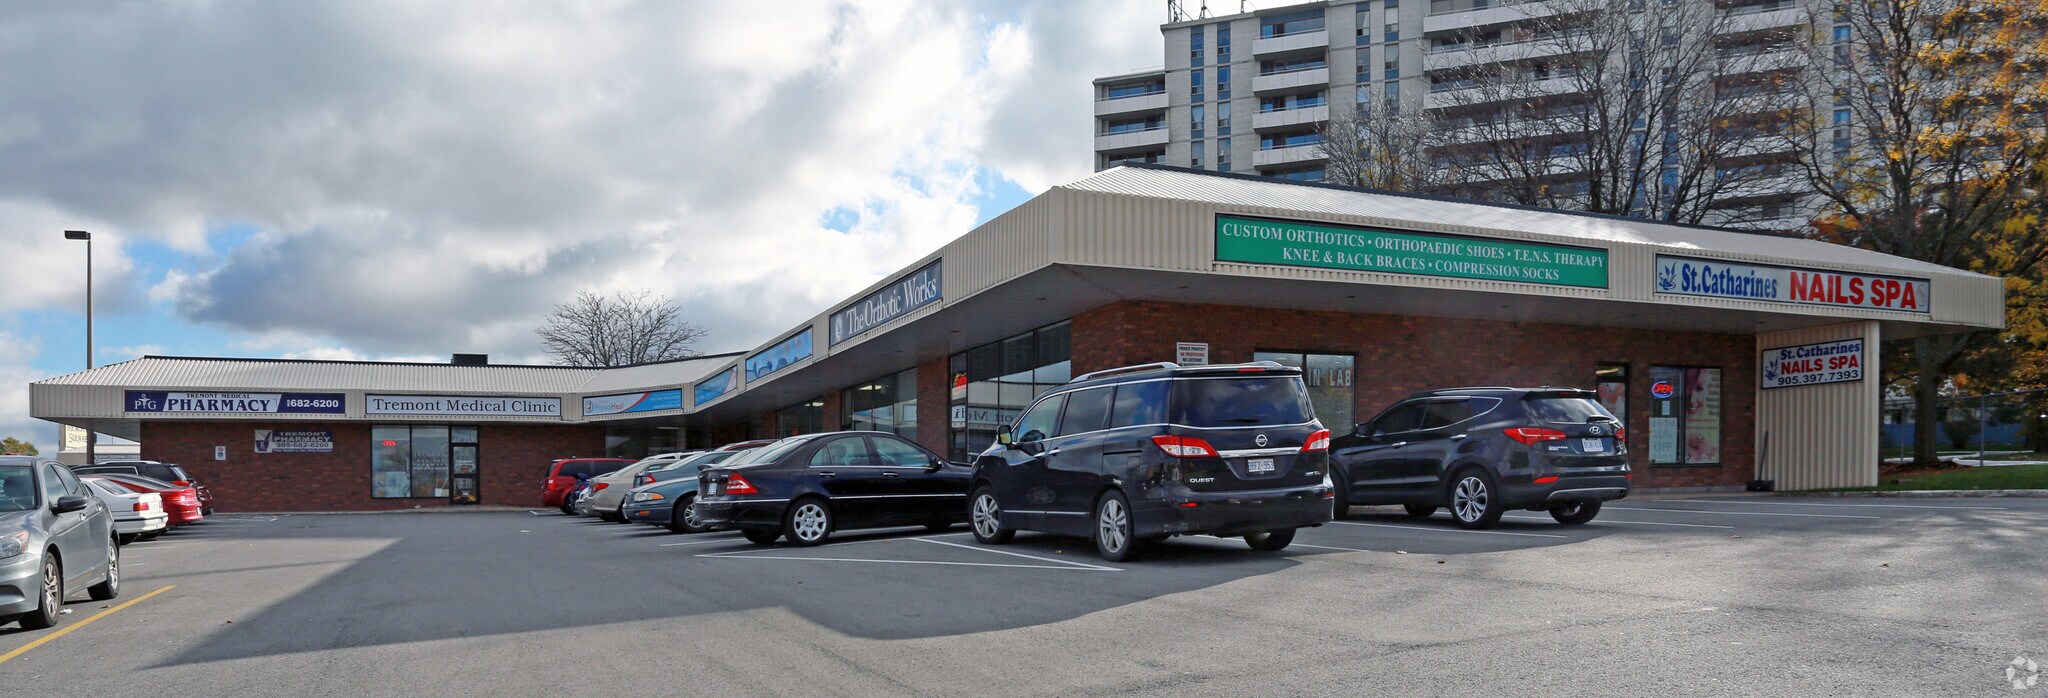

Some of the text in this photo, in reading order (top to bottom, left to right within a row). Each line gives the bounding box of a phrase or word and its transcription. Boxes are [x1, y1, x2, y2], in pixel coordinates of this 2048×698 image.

[1222, 223, 1606, 268] CUSTOM ORTHOTICS ORTHOPAEDIC SHOES T.E.N.S. THERAPY
[1283, 247, 1559, 280] KNEE & BACK BRACES COMPRESSION SOCKS
[1790, 271, 1865, 305] NAILS
[1870, 279, 1917, 309] SPA
[847, 271, 937, 335] The Orthotic Works
[1781, 354, 1859, 375] NAILS SPA
[1329, 369, 1351, 387] LAB
[1778, 370, 1859, 386] 905.397.7393
[167, 399, 271, 412] PHARMACY
[290, 399, 339, 408] 682-6200
[373, 399, 556, 413] Tremont Medical Clinic
